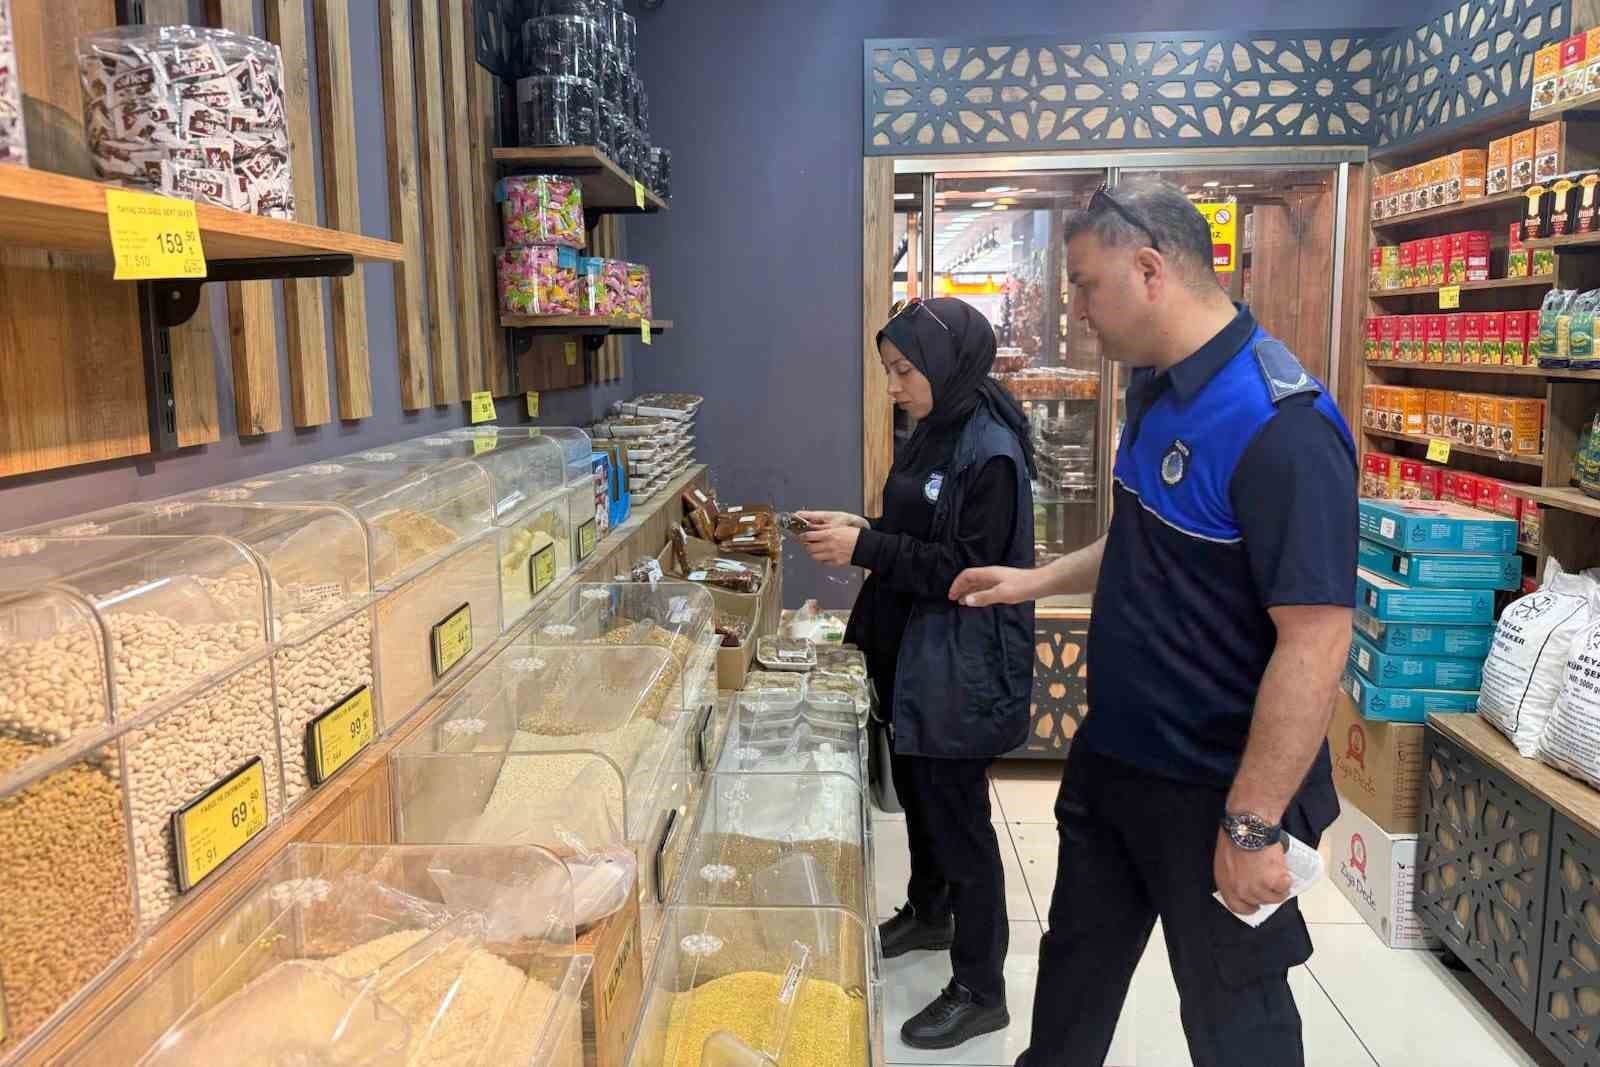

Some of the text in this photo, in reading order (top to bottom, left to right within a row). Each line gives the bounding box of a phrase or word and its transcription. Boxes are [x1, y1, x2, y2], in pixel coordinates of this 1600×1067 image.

[156, 233, 184, 255] 159
[350, 717, 361, 738] 99
[231, 801, 248, 828] 69
